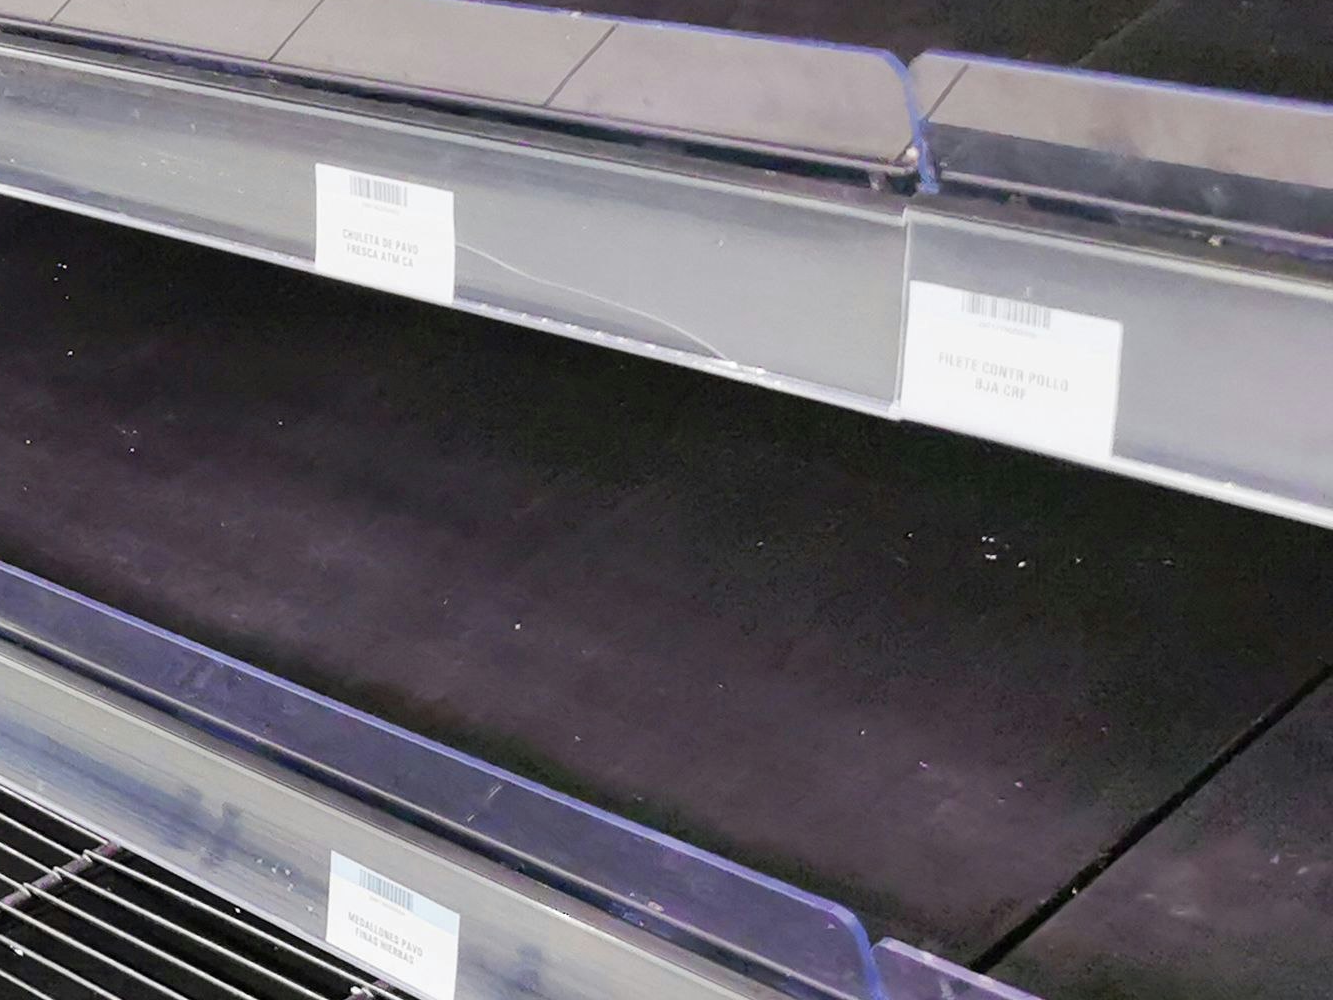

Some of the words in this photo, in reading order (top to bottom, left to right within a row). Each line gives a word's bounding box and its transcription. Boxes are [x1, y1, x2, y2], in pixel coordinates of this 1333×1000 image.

[342, 229, 380, 246] CHULETA
[382, 238, 393, 248] DE
[395, 240, 419, 255] PAVO
[347, 243, 378, 259] FRESCA
[380, 252, 400, 264] ATM
[938, 352, 978, 372] FILETE
[982, 361, 1025, 382] CONTR
[1028, 371, 1070, 393] POLLO
[974, 377, 999, 395] BJA
[1003, 384, 1027, 401] CRF
[348, 912, 399, 945] MEDALLONES
[402, 938, 423, 957] PAVO
[355, 927, 378, 947] FINAS
[380, 939, 415, 965] HIERBAS
